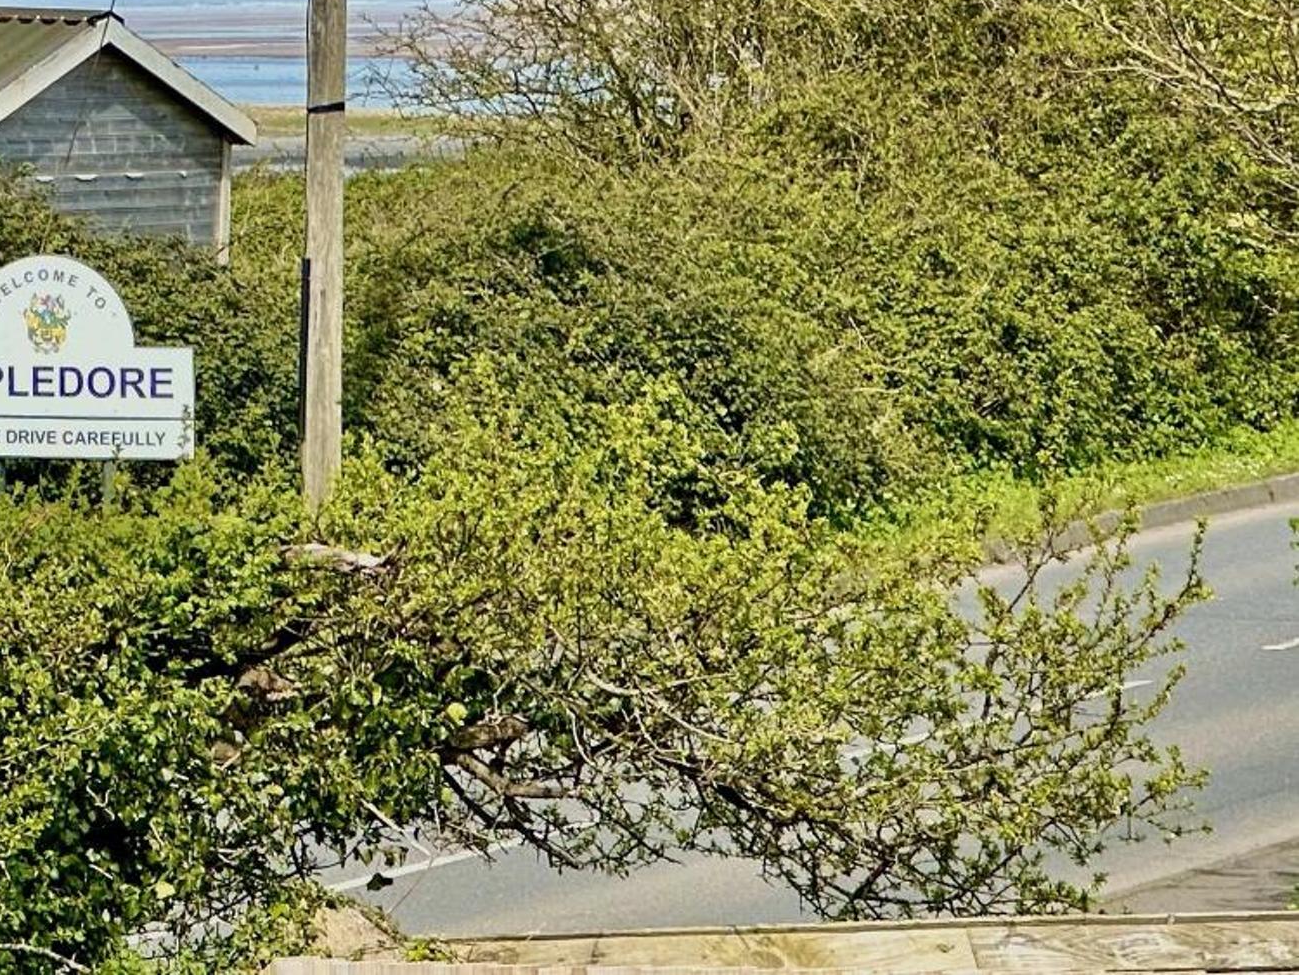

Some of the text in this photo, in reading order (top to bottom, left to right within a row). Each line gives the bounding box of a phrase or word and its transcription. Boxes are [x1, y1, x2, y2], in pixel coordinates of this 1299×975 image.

[86, 285, 107, 310] TO
[6, 429, 57, 444] DRIVE
[62, 430, 166, 446] CAREFULLY
